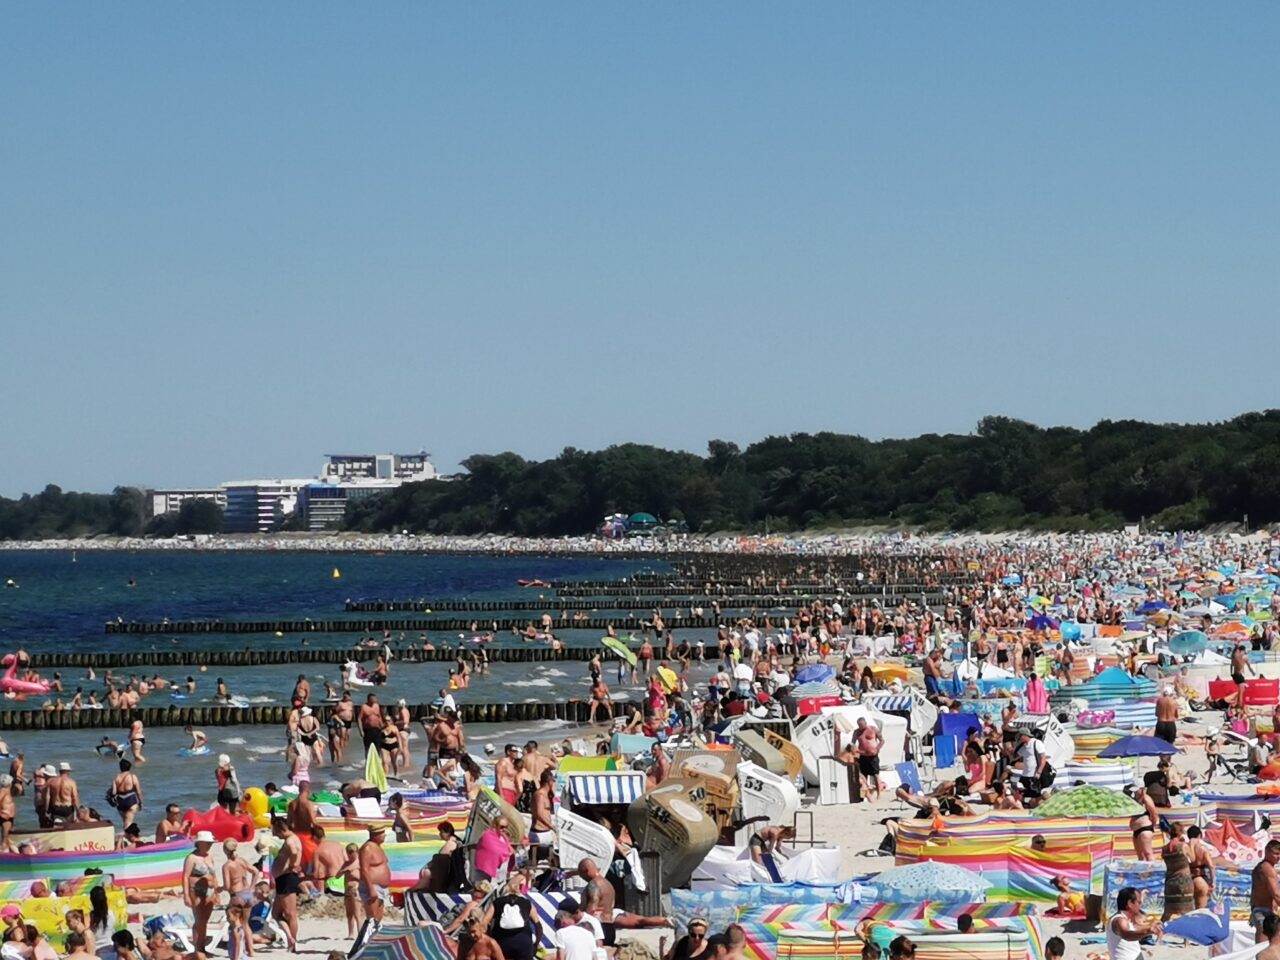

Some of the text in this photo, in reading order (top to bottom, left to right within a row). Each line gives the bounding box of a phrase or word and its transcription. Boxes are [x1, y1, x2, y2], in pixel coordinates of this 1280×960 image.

[811, 718, 834, 737] 612
[1050, 721, 1064, 738] 02
[744, 776, 765, 792] 53
[688, 785, 706, 803] 50
[560, 819, 575, 832] 72
